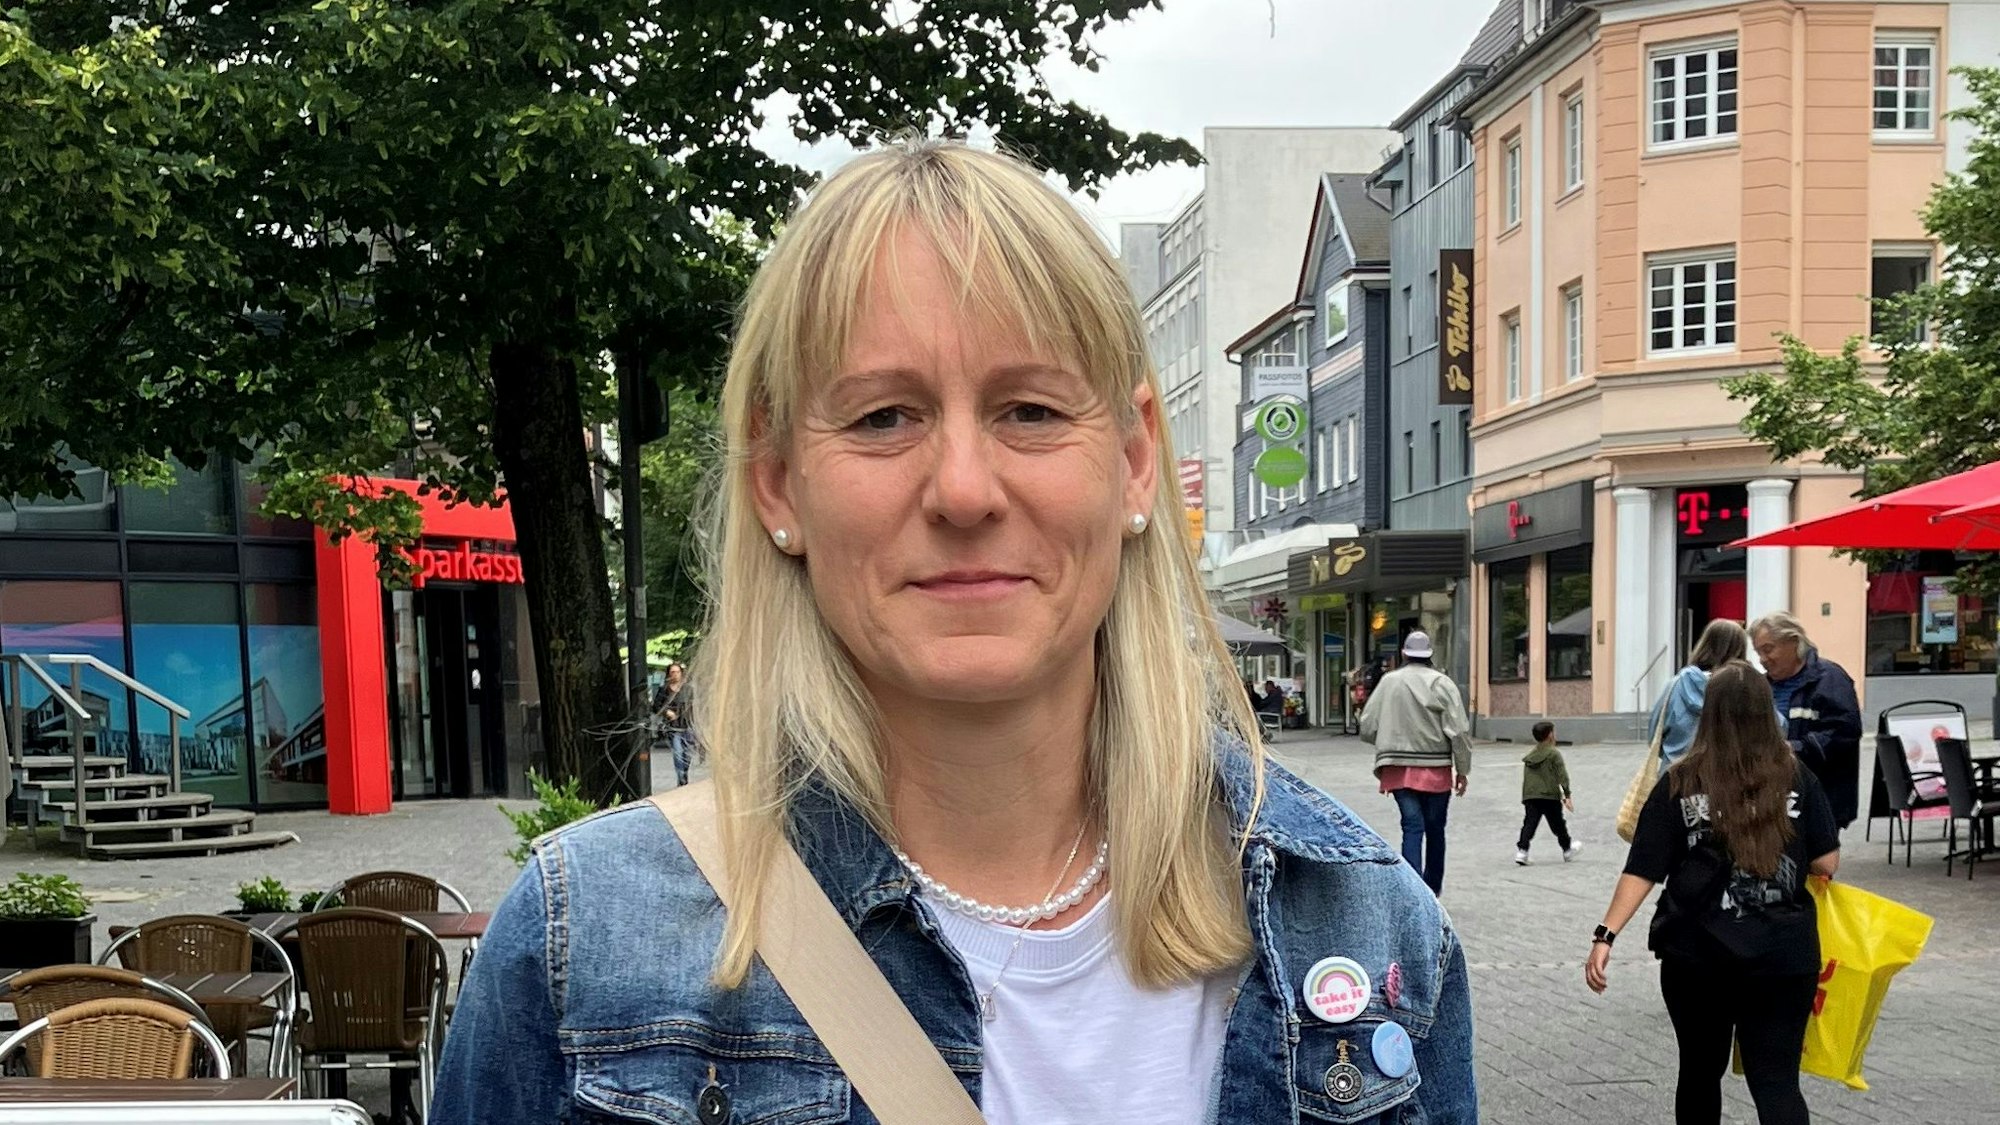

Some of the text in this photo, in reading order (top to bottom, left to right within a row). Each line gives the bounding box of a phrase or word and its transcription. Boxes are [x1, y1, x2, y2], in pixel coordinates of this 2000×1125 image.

[1446, 262, 1469, 357] Tchibo
[1258, 373, 1303, 381] PASSFOTOS
[1314, 987, 1365, 1006] take it
[1326, 1003, 1357, 1017] easy
